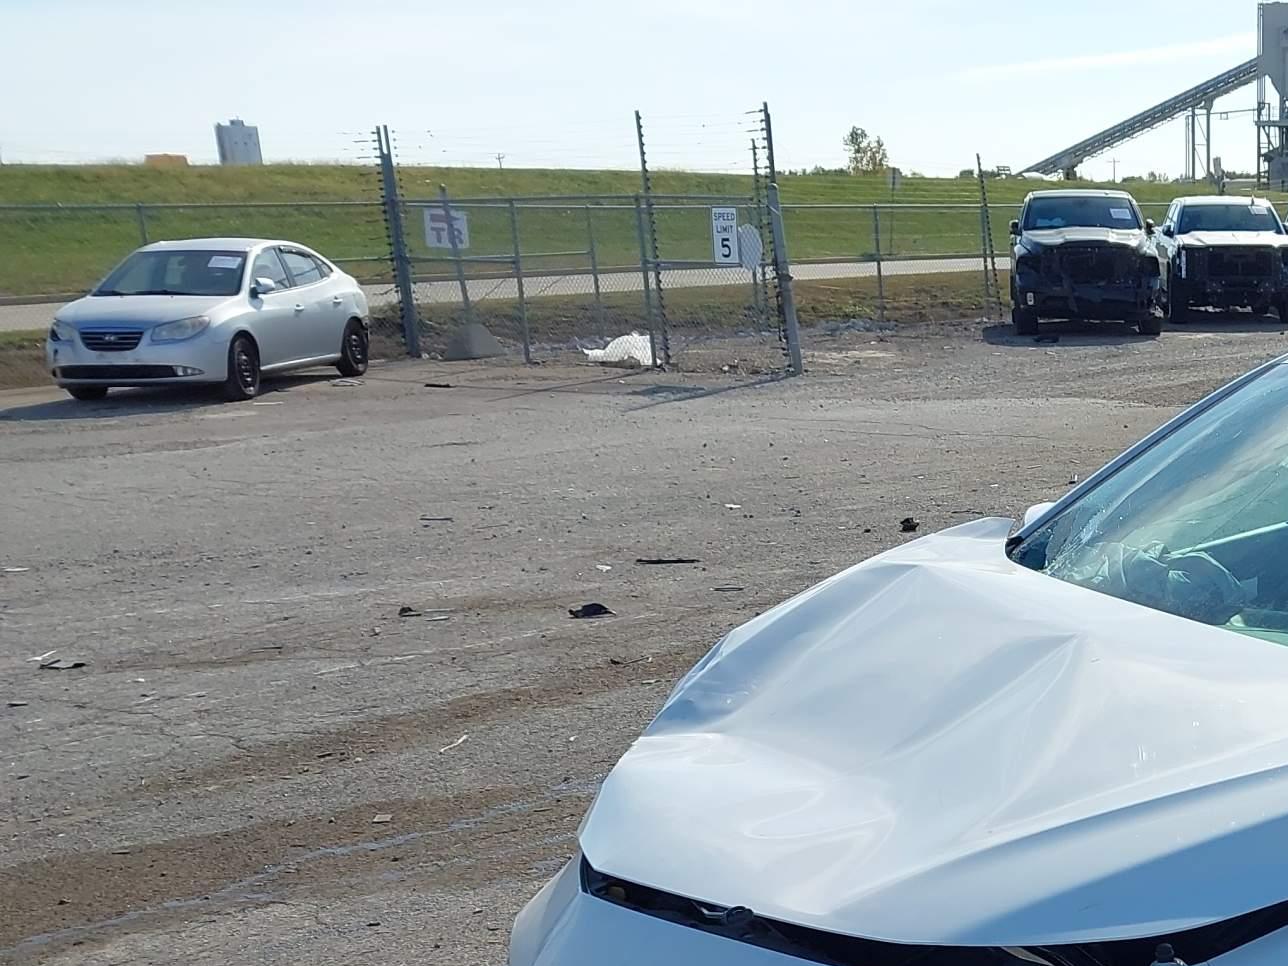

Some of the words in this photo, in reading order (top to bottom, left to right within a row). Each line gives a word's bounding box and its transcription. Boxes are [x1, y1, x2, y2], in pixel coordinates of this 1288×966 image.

[713, 212, 735, 221] SPEED
[716, 225, 733, 233] LIMIT
[721, 237, 732, 258] 5
